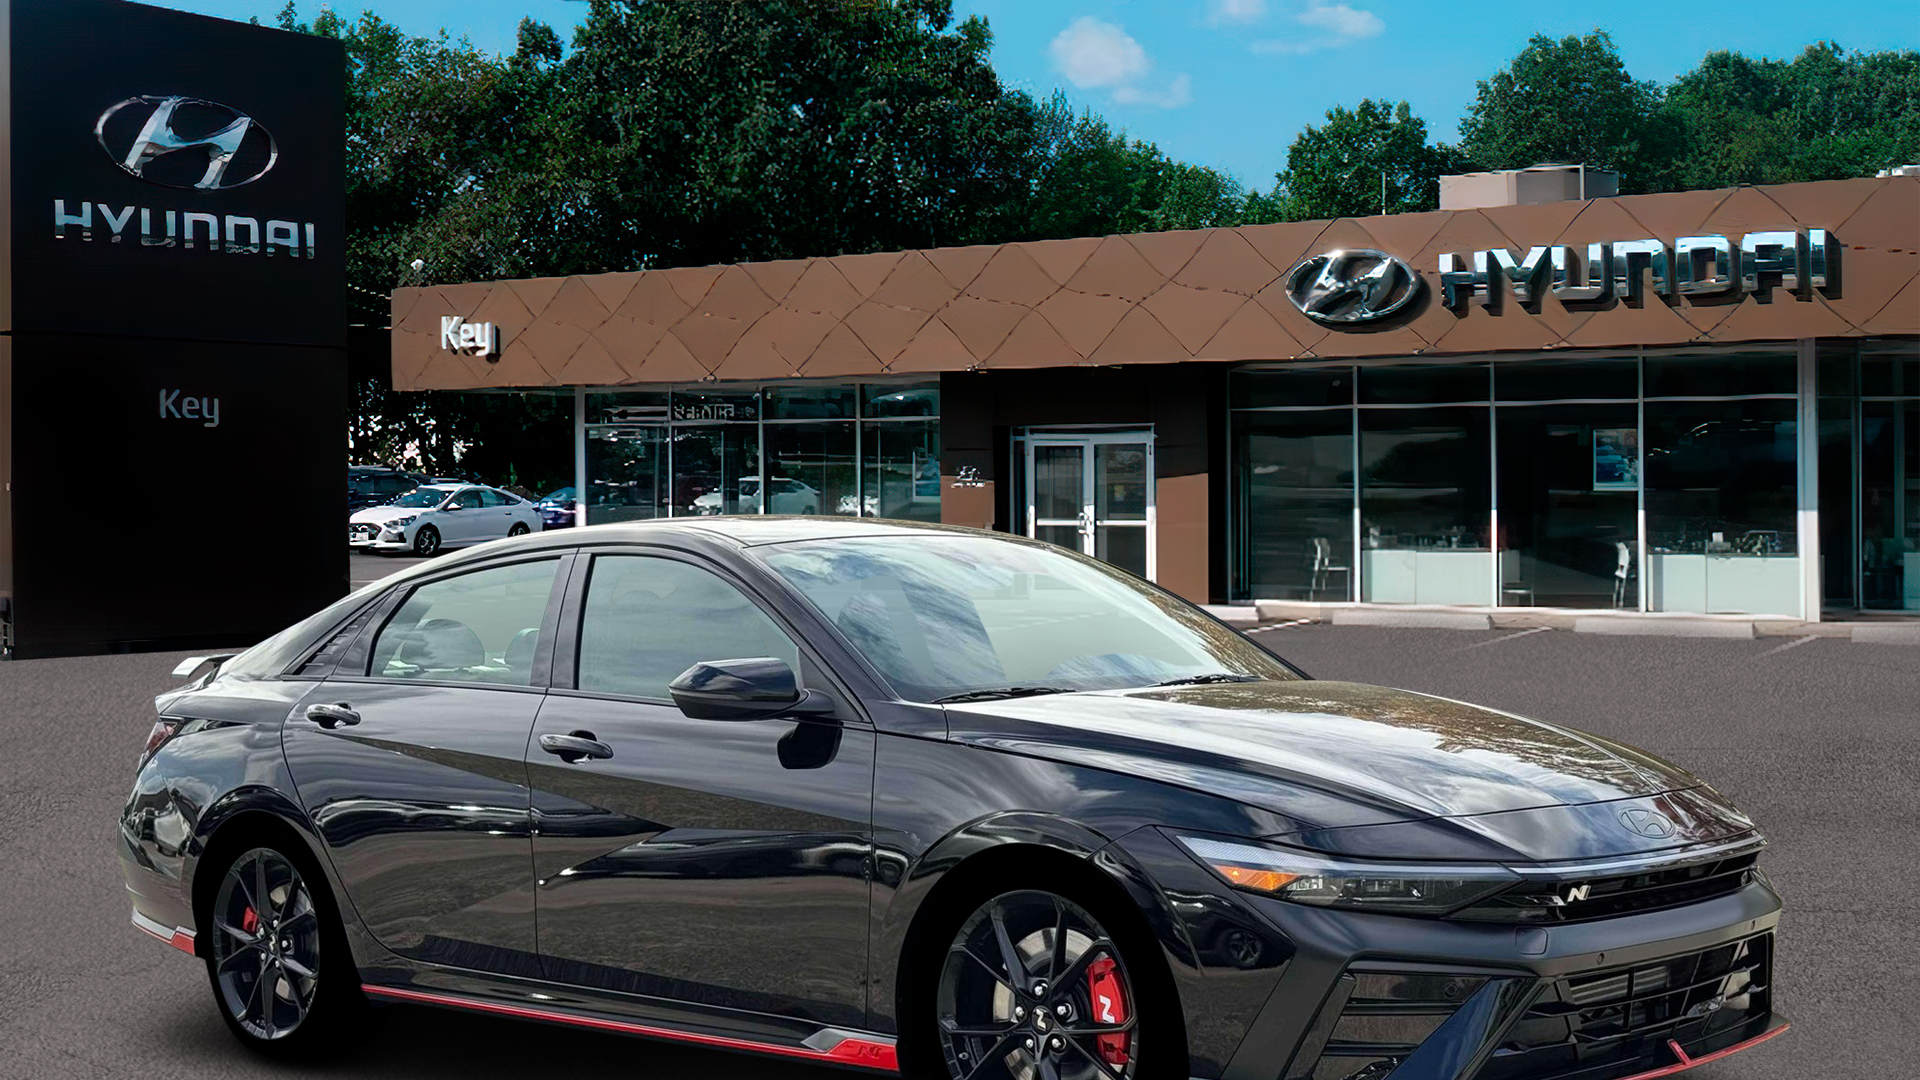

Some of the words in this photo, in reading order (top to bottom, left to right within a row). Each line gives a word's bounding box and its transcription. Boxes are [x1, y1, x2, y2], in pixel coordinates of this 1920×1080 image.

[54, 199, 316, 260] HYUNDAI
[1438, 228, 1840, 314] HYUNDAI
[440, 315, 495, 357] Key
[158, 388, 220, 428] Key
